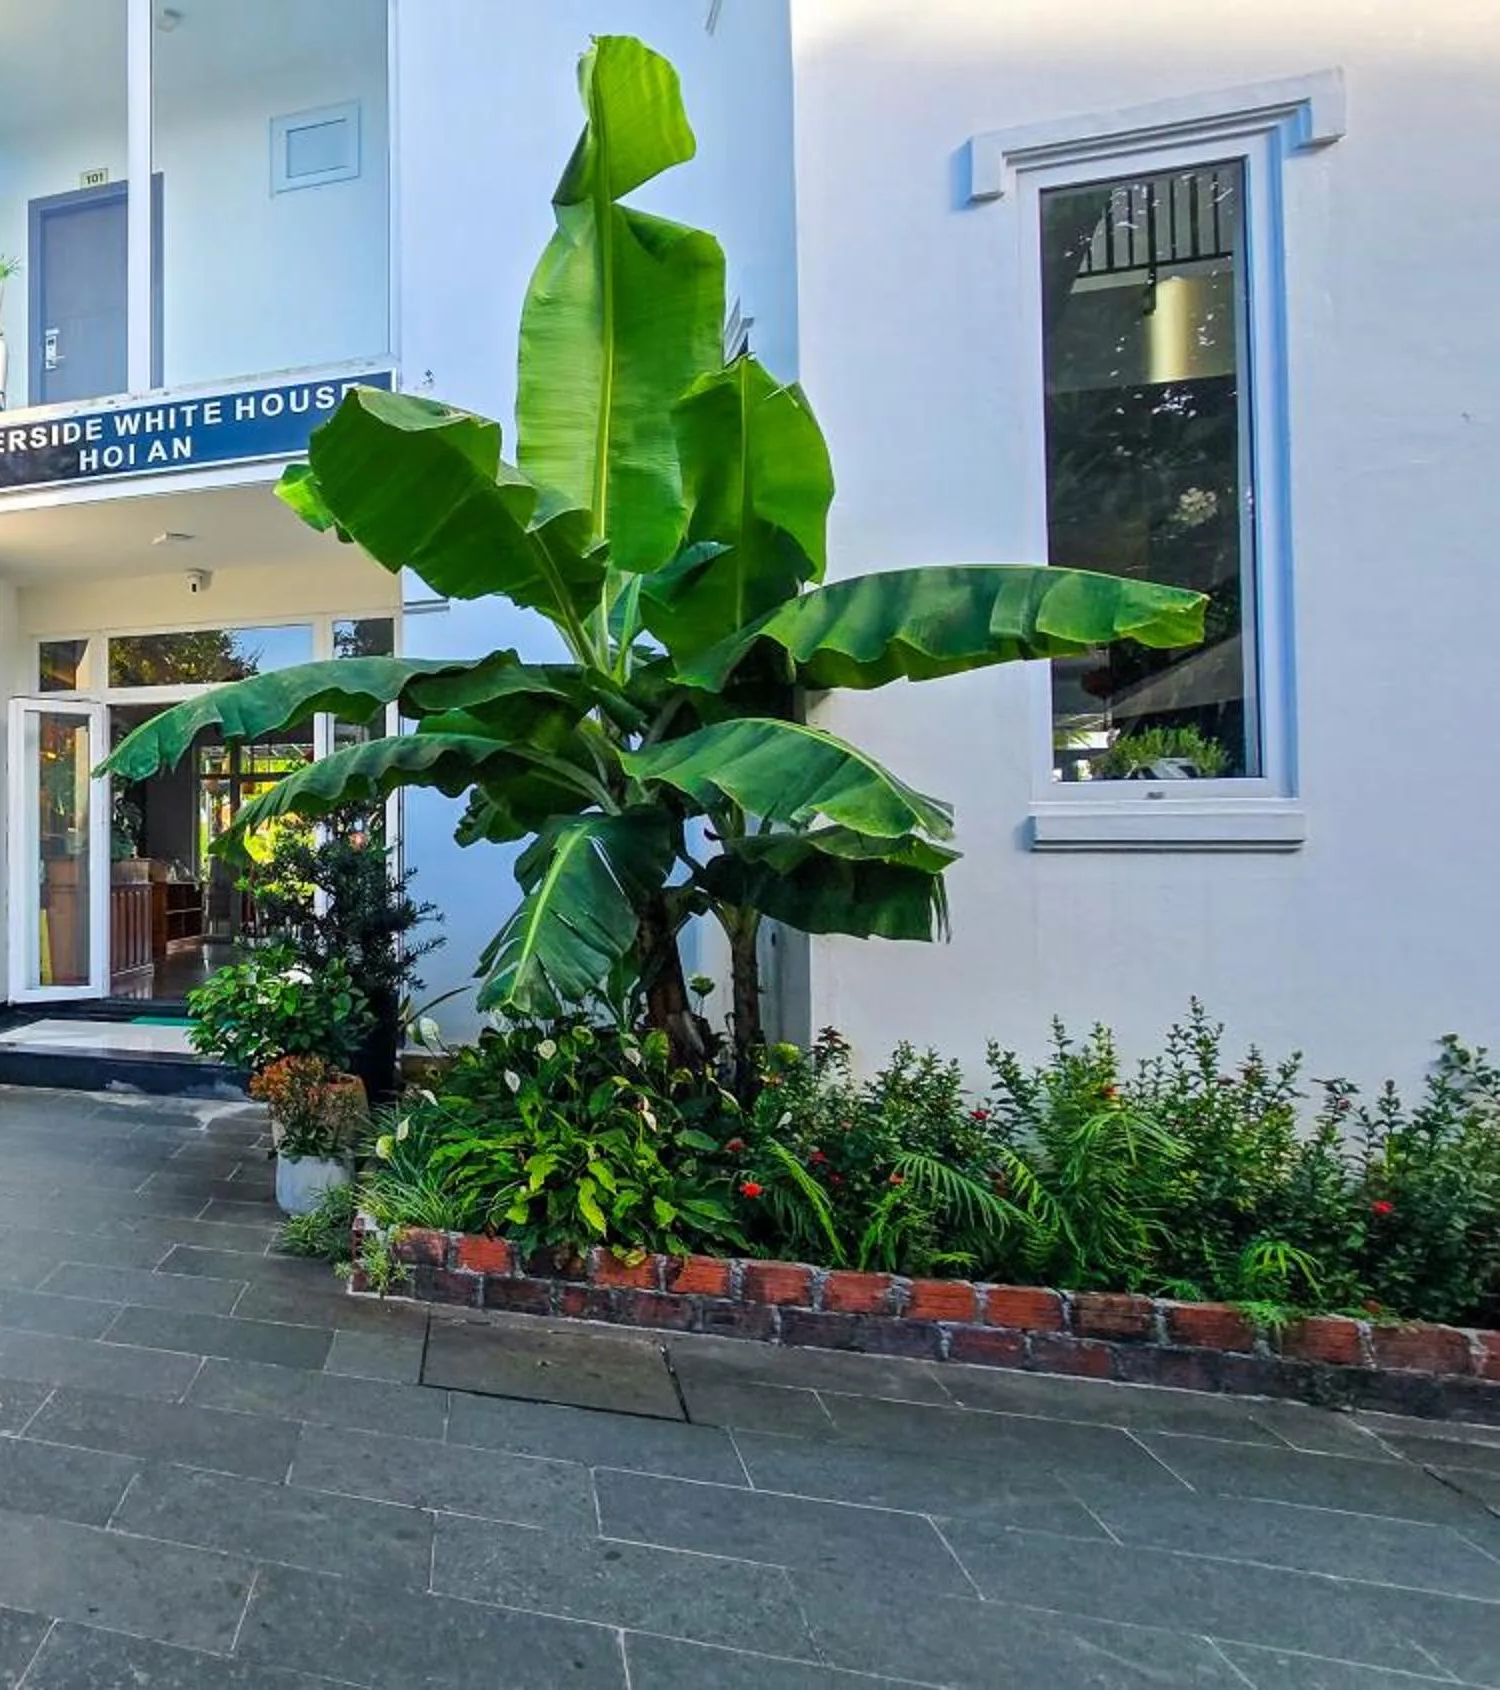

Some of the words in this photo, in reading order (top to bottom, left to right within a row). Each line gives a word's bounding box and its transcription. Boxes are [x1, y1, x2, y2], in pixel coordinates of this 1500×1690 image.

[86, 172, 104, 184] 101
[114, 401, 222, 436] WHITE
[79, 443, 136, 471] HOI
[147, 436, 192, 463] AN
